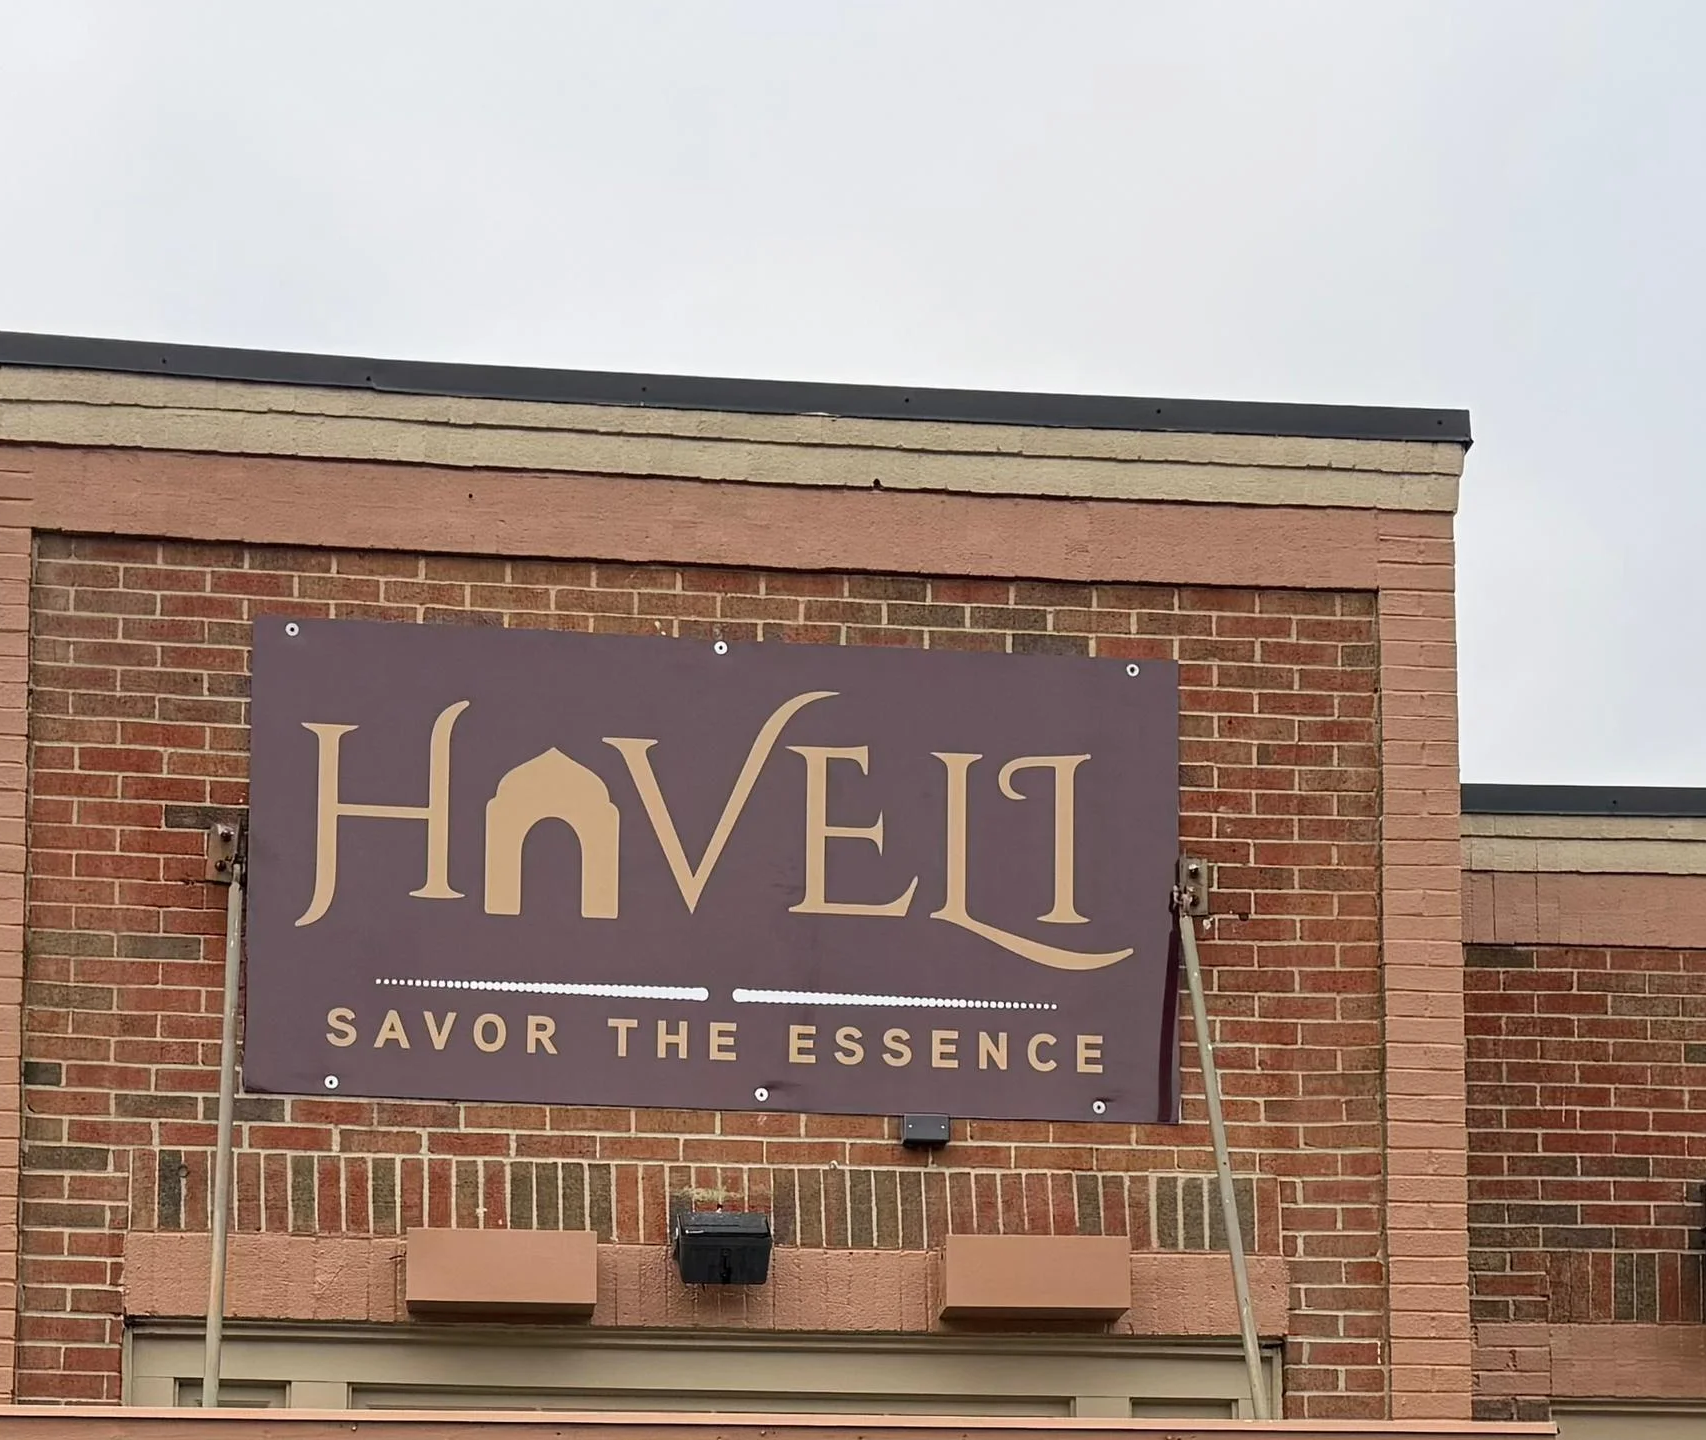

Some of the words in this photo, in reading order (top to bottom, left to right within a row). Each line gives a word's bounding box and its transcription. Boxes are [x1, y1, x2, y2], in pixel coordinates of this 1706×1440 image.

[325, 1006, 559, 1056] SAVOR
[608, 1017, 739, 1063] THE
[786, 1023, 1105, 1075] ESSENCE
